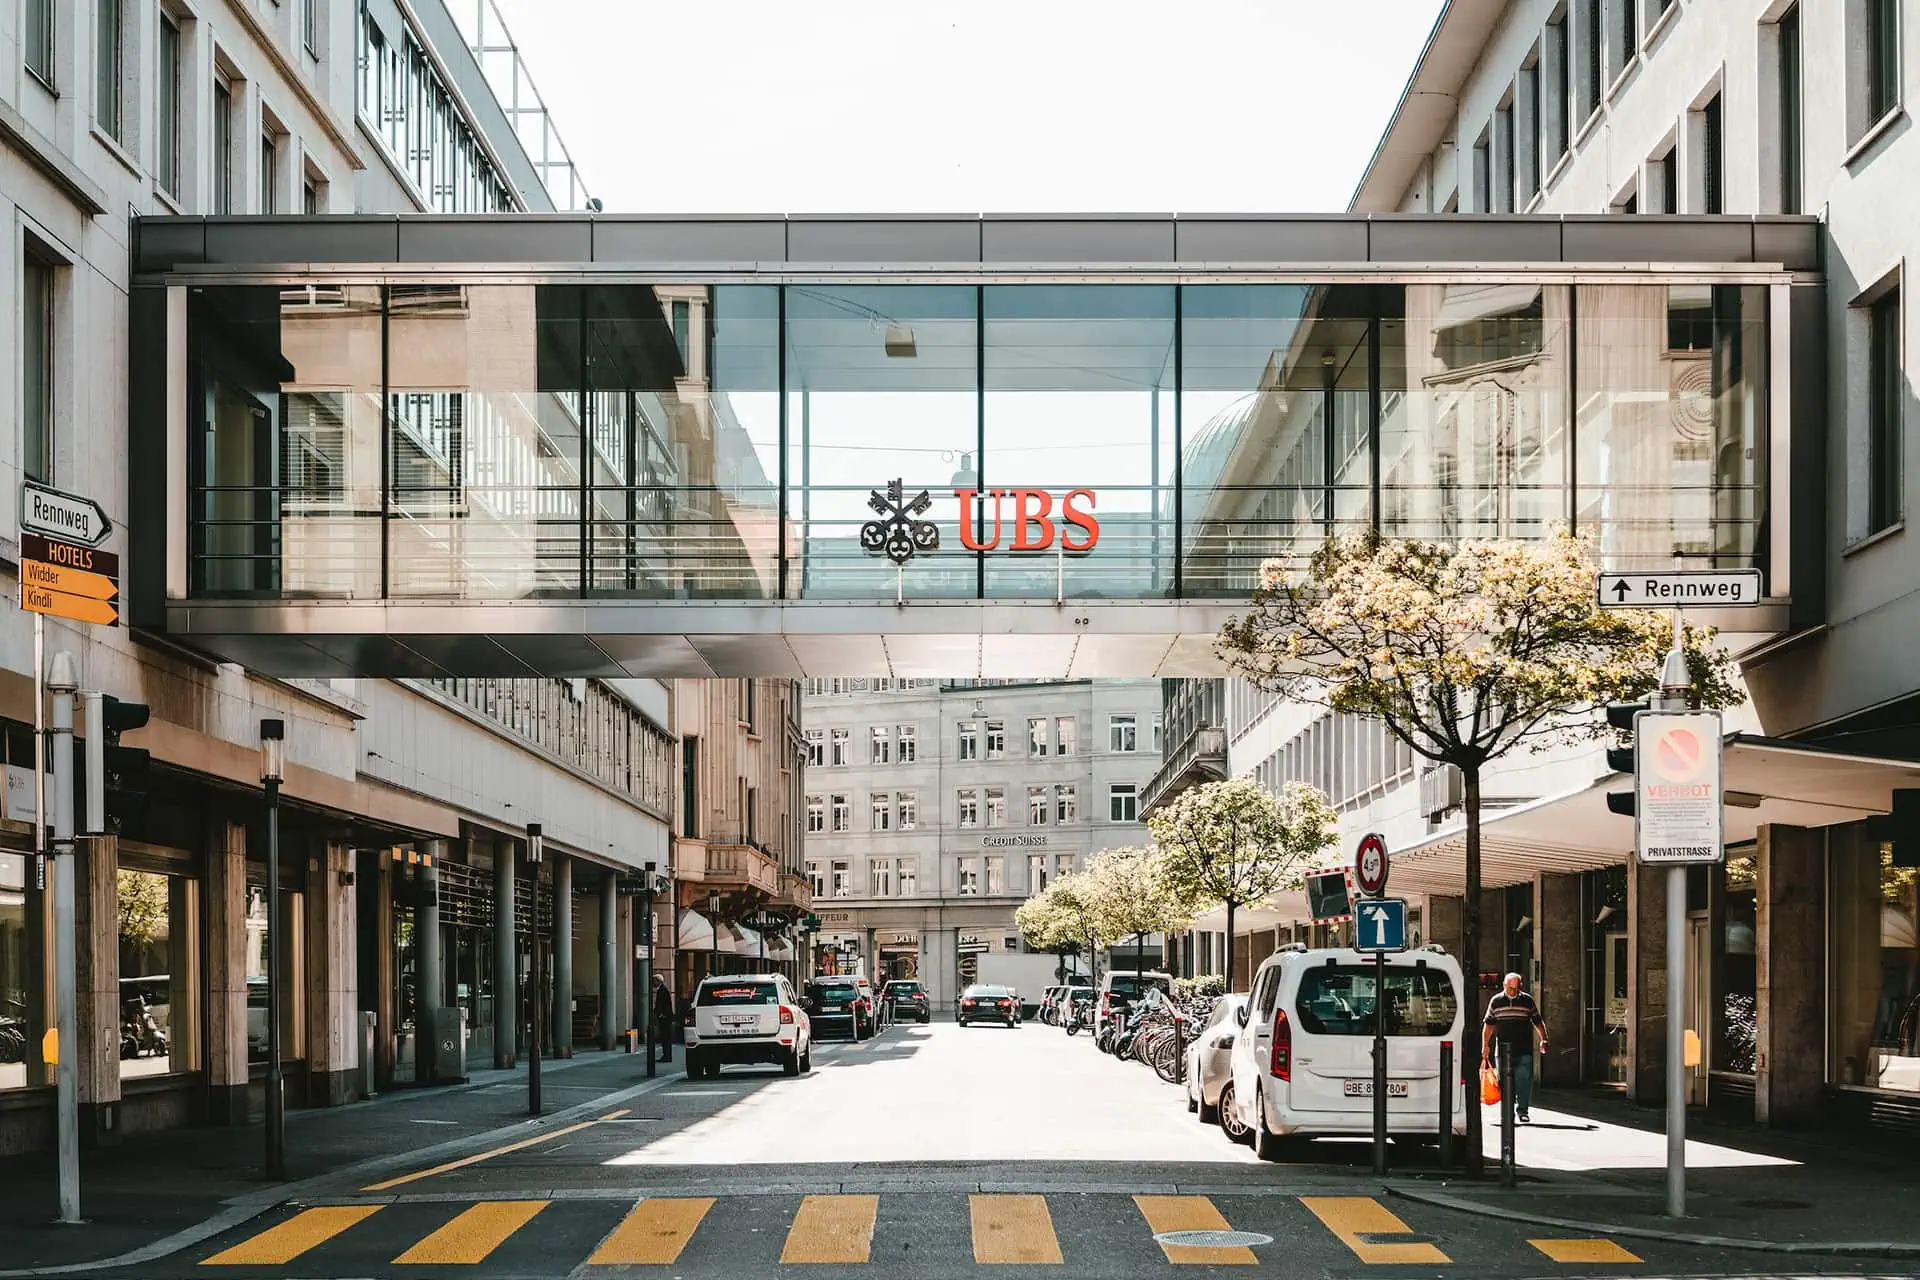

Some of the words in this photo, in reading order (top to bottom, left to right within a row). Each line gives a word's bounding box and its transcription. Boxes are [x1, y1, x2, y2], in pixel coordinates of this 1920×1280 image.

[34, 495, 89, 537] Rennweg
[954, 488, 1100, 551] UBS
[48, 542, 93, 569] HOTELS
[27, 564, 59, 584] Widder
[27, 590, 52, 609] Kindli
[1645, 579, 1742, 601] Rennweg
[1647, 784, 1712, 797] VERBOT
[1648, 846, 1713, 857] PRIVATSTRASSE
[816, 913, 849, 921] IFFEUR
